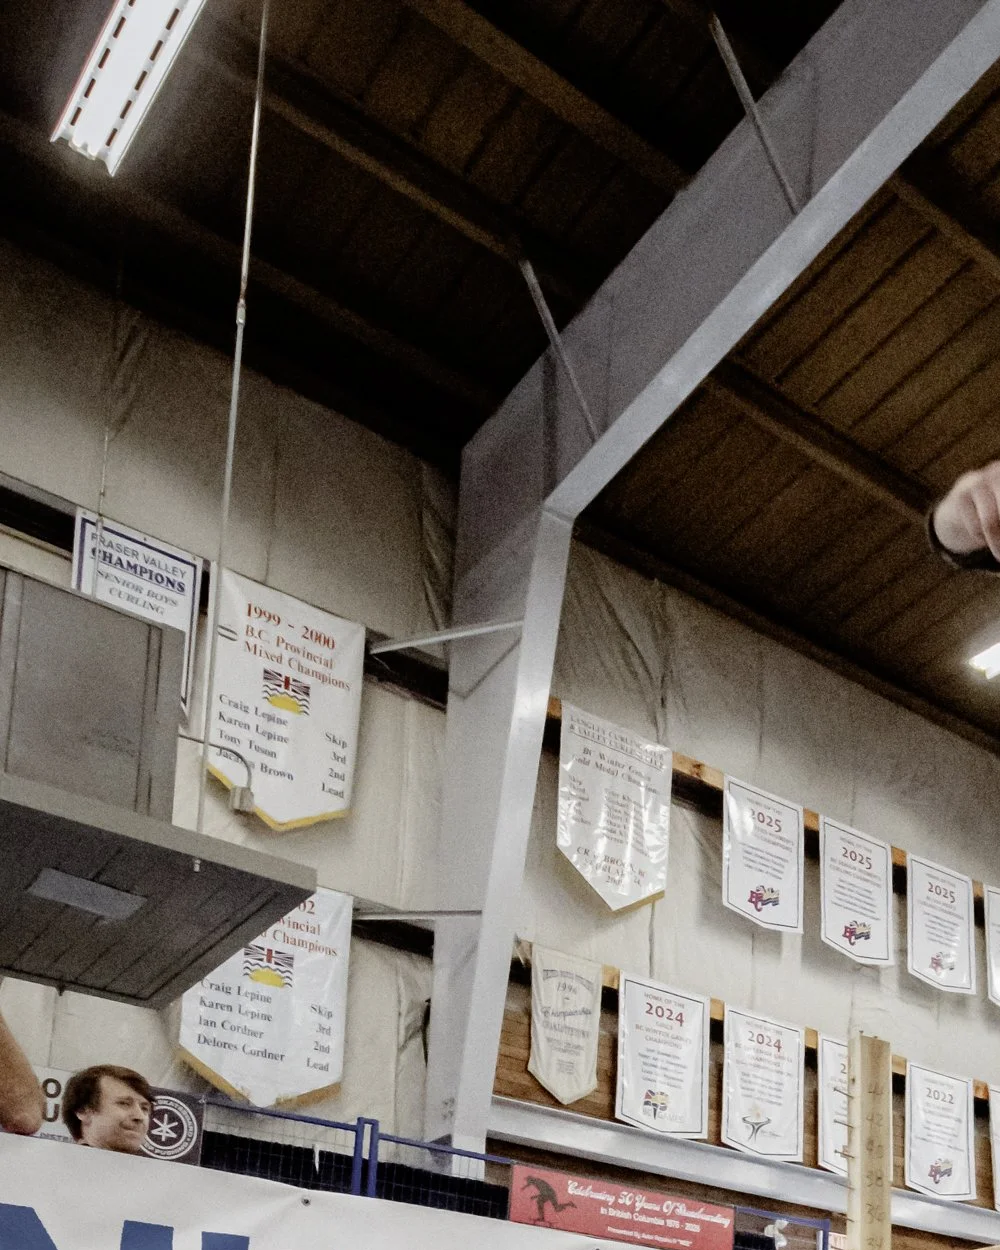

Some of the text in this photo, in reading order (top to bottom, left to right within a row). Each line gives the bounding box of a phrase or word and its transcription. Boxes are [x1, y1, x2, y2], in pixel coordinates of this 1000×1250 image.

[91, 532, 187, 578] FRASER VALLEY
[91, 547, 185, 594] CHAMPIONS
[97, 569, 178, 607] SENIOR BOYS
[109, 587, 165, 615] CURLING
[247, 602, 281, 626] 1999
[302, 625, 336, 650] 2000
[244, 641, 350, 691] Mixed Champions
[276, 635, 334, 670] Provincial
[218, 712, 346, 765] Karen Lepine 3rd
[219, 694, 347, 749] Craig Lepine Skip
[218, 729, 241, 745] Tony
[329, 768, 346, 782] 2nd
[260, 763, 294, 781] Brown
[322, 782, 345, 799] Lead
[750, 808, 782, 833] 2025
[842, 846, 872, 870] 2025
[299, 900, 316, 916] 02
[927, 881, 956, 904] 2025
[273, 930, 338, 957] Champions
[200, 996, 332, 1036] Karen Lepine 3rd
[201, 978, 333, 1020] Craig Lepine Skip
[645, 1002, 685, 1027] 2024
[197, 1033, 238, 1052] Delores
[306, 1058, 330, 1073] Lead
[199, 1016, 217, 1030] Ian
[313, 1041, 331, 1054] 2nd
[747, 1030, 782, 1052] 2024
[926, 1087, 955, 1105] 2022
[618, 1191, 634, 1205] 50
[608, 1208, 632, 1219] British
[633, 1212, 665, 1226] Columbia
